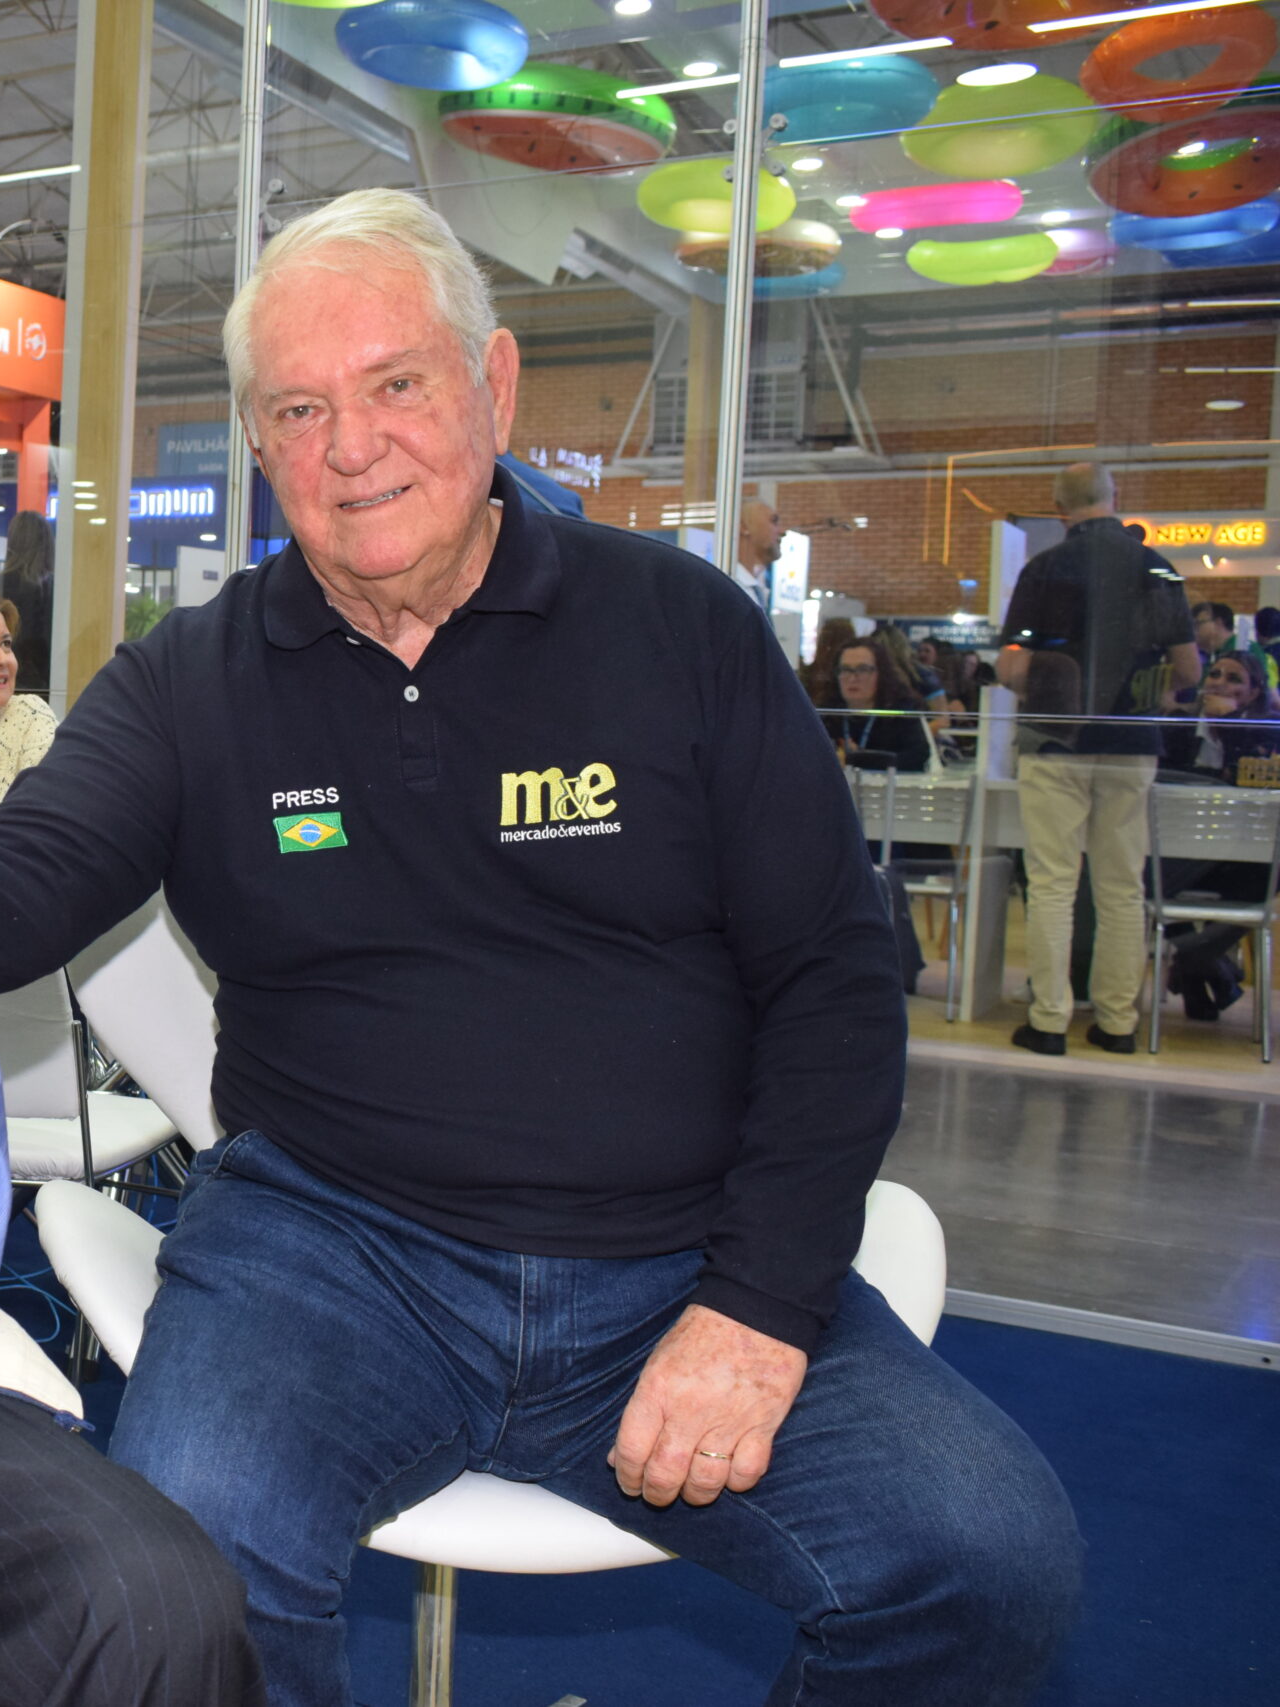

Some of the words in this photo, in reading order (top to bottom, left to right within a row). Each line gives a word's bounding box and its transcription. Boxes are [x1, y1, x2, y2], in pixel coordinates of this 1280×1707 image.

[167, 435, 229, 454] PAVILHÃ
[1155, 523, 1212, 546] NEW
[1214, 521, 1266, 546] AGE
[272, 787, 339, 810] PRESS
[500, 762, 617, 826] m&e
[500, 821, 622, 843] mercado&eventos
